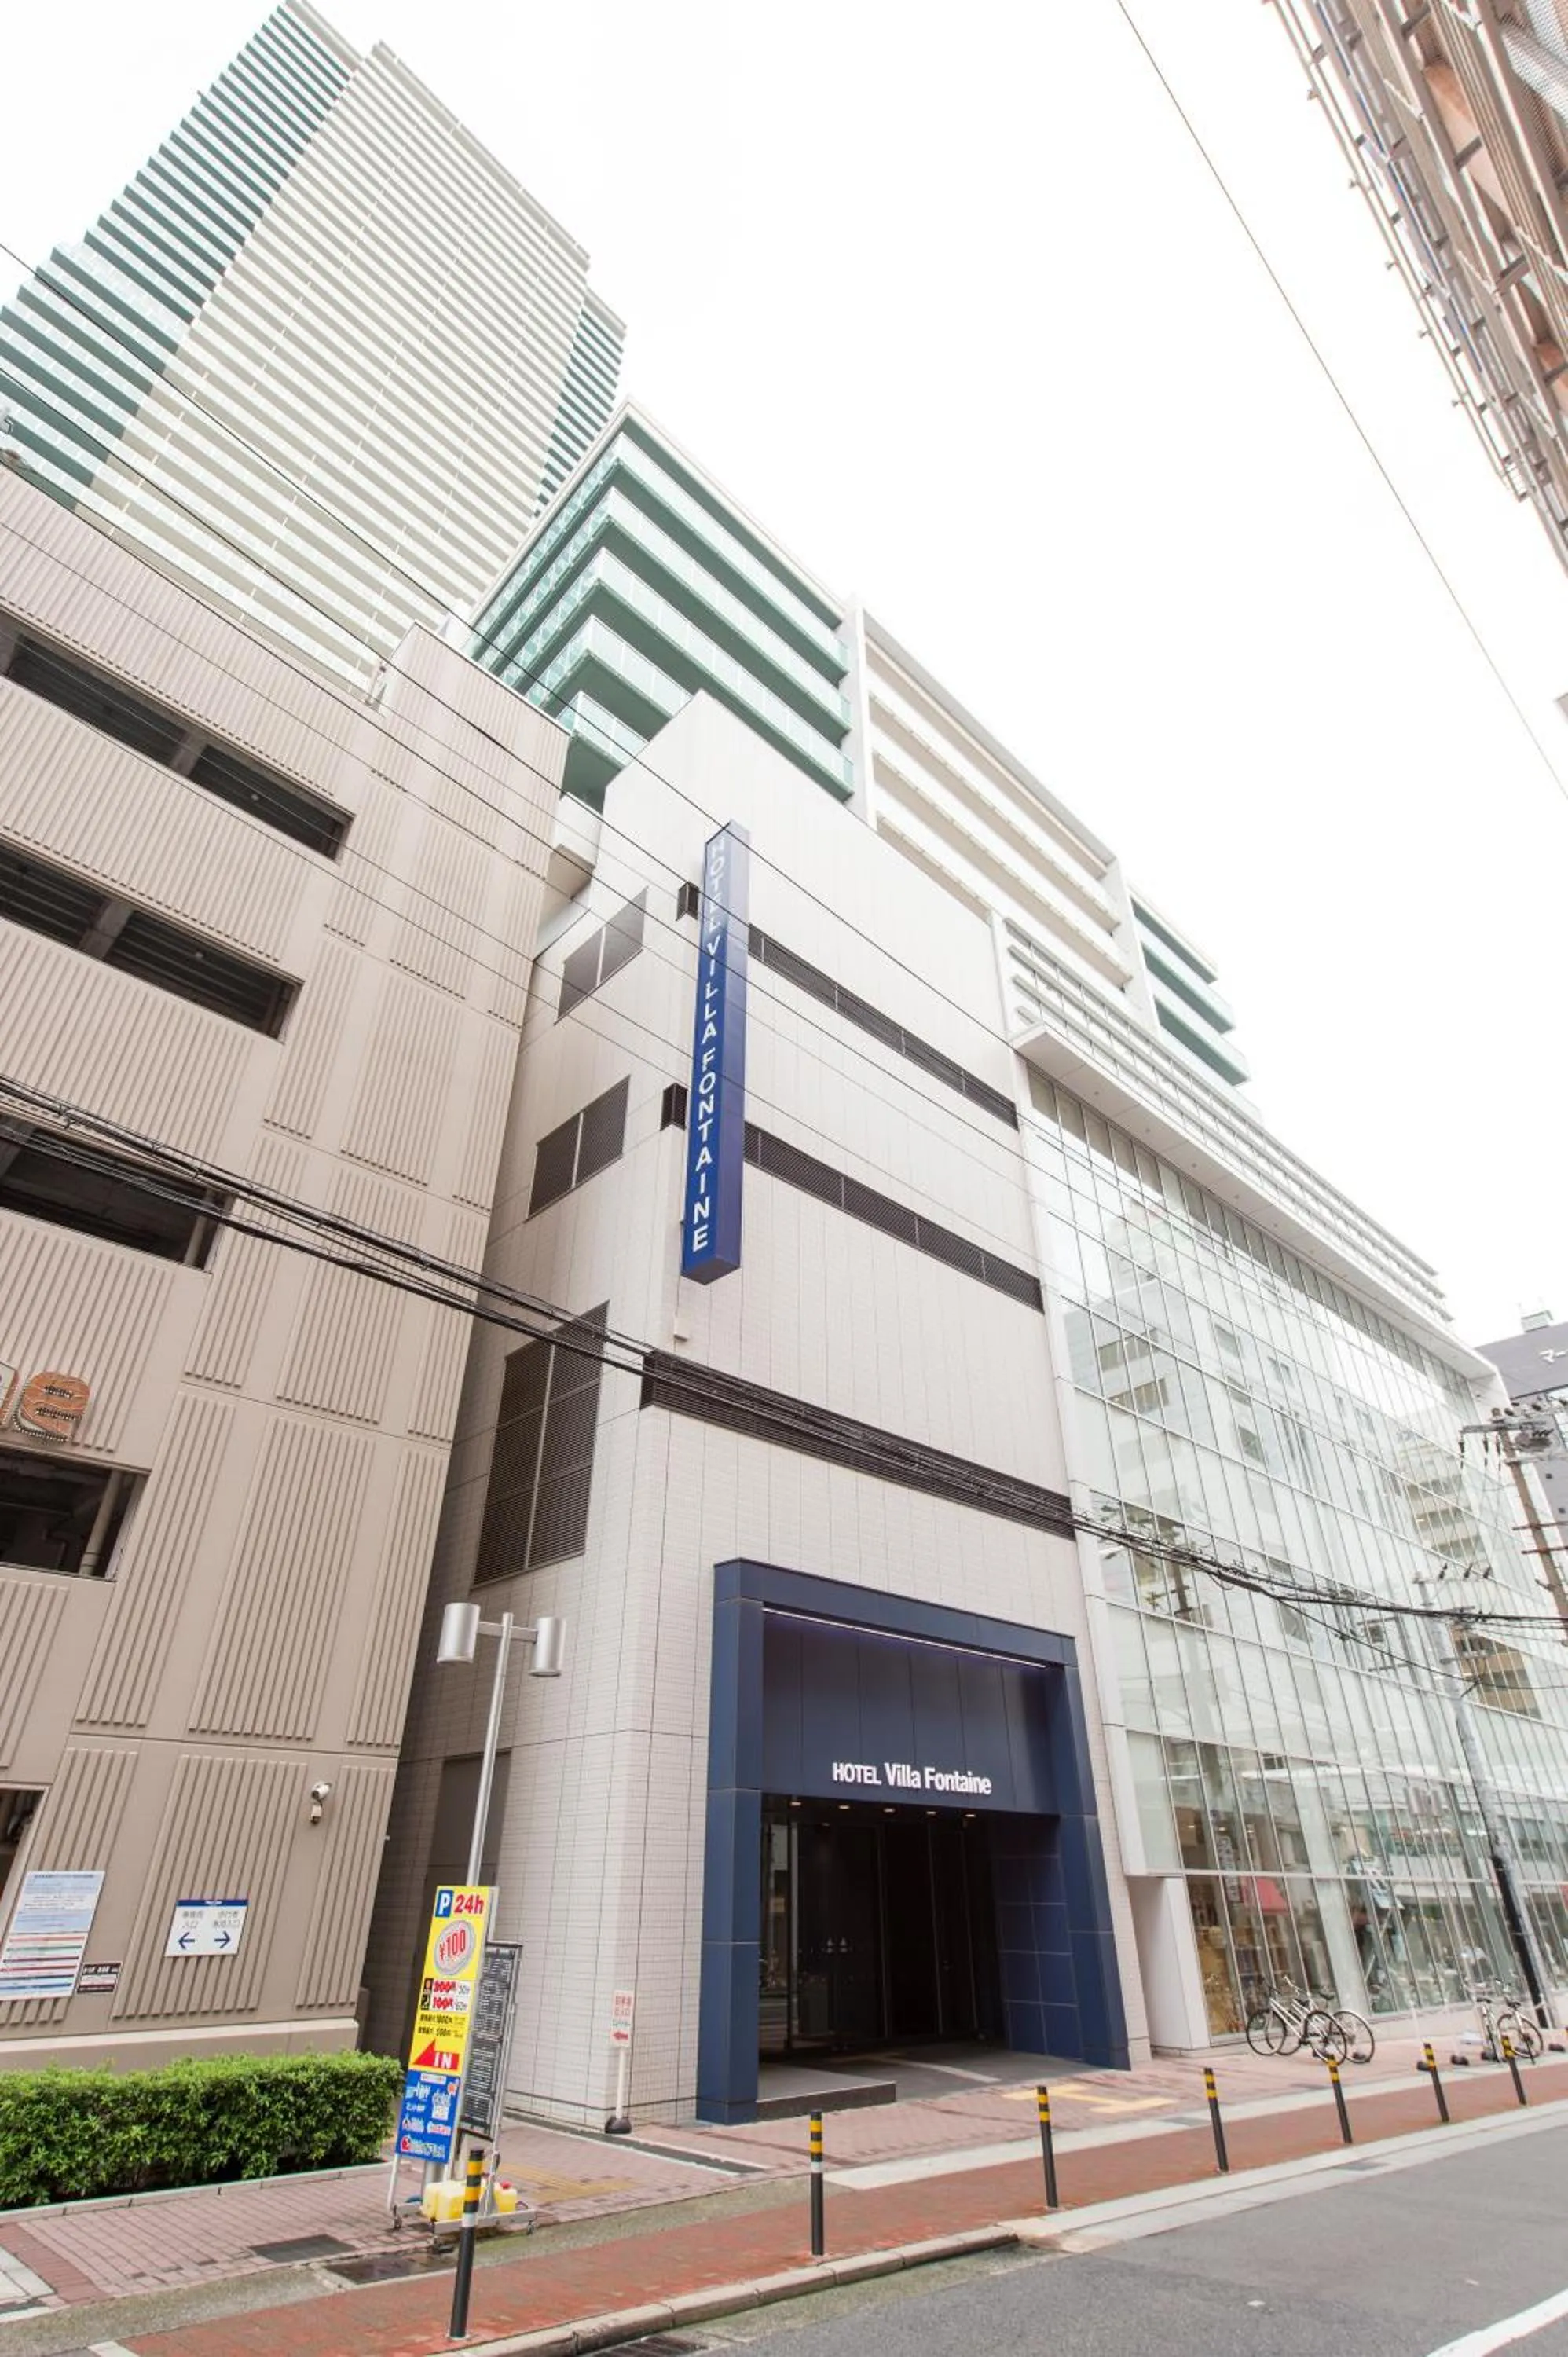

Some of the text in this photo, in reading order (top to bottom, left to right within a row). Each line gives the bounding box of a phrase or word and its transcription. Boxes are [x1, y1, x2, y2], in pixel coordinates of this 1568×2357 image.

[692, 837, 725, 1252] HOTEL VILLA FONTAINE
[832, 1762, 992, 1795] HOTEL Villa Fontaine
[438, 1892, 485, 1915] P 24h
[434, 2051, 453, 2069] IN
